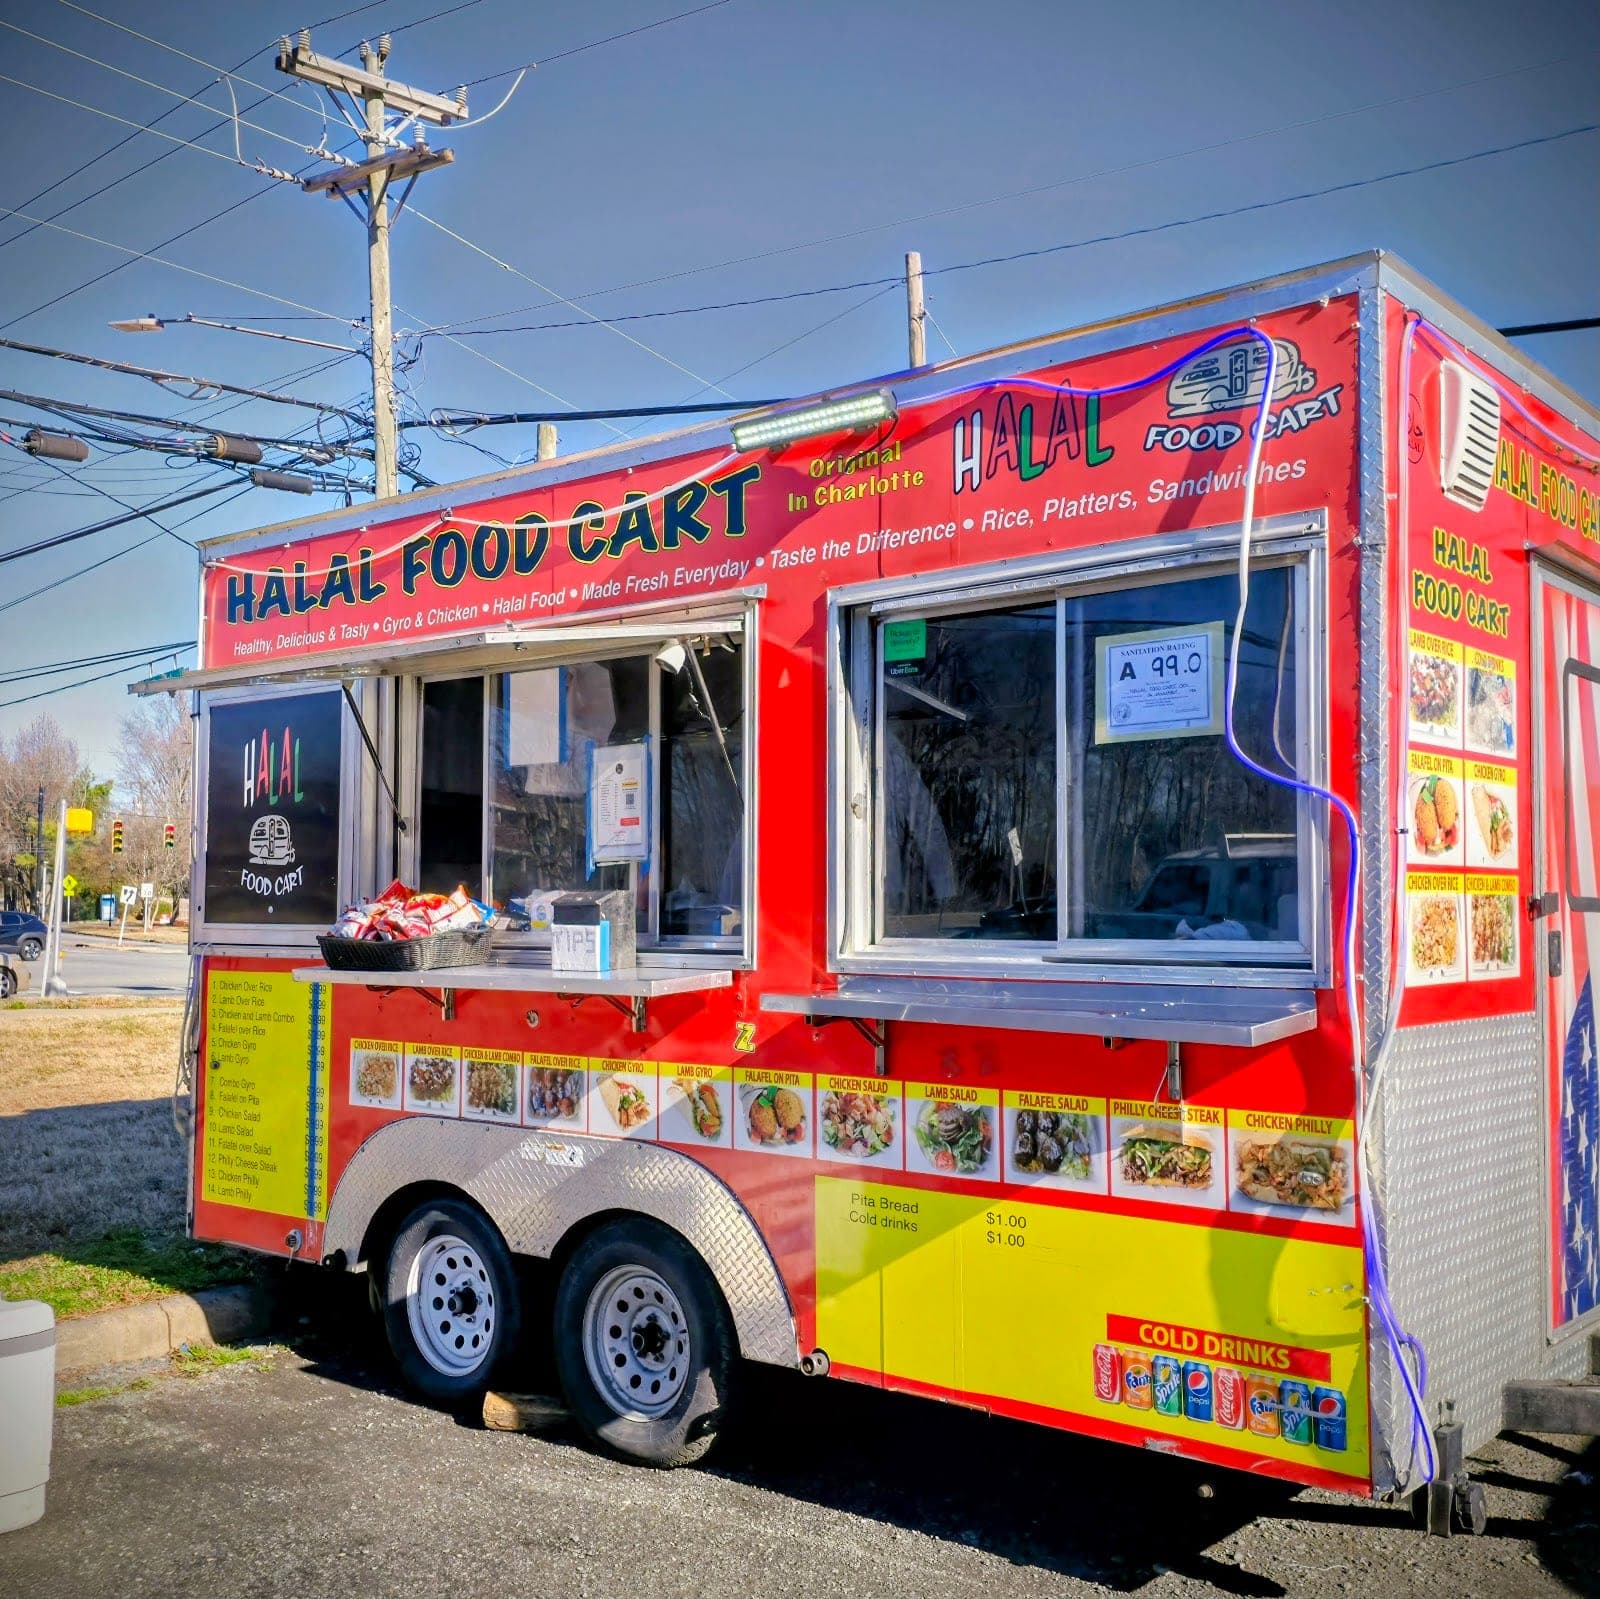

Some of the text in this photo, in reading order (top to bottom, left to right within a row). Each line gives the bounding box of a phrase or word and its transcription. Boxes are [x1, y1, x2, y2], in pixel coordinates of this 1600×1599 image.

[1144, 385, 1343, 451] FOOD CART
[954, 379, 1115, 495] HALAL
[809, 442, 902, 479] Original
[788, 468, 925, 513] In Charlotte
[1540, 463, 1578, 529] FOOD
[226, 463, 761, 625] HALAL FOOD CART
[1433, 526, 1493, 584] HALAL
[234, 638, 273, 656] Healthy,
[276, 631, 325, 650] Delicious
[328, 627, 336, 641] &
[341, 622, 369, 641] Tasty
[383, 615, 412, 634] Gyro
[415, 612, 423, 626] &
[427, 604, 478, 624] Chicken
[493, 596, 526, 615] Halal
[531, 588, 565, 608] Food
[583, 581, 620, 601] Made
[626, 572, 669, 594] Fresh
[674, 558, 749, 588] Everyday
[770, 545, 816, 570] Taste
[822, 539, 850, 559] the
[857, 521, 957, 555] Difference
[982, 506, 1033, 532] Rice,
[1044, 487, 1137, 521] Platters,
[1413, 569, 1510, 639] FOOD CART
[1121, 642, 1196, 656] SANITATION RATING
[1120, 652, 1201, 680] A 99.0
[243, 727, 304, 808] HALAL
[241, 865, 303, 896] FOOD CART
[602, 1061, 644, 1073] CHICKEN GYRO
[677, 1066, 713, 1078] LAMB GYRO
[745, 1071, 800, 1085] FALAFEL ON PITA
[830, 1078, 888, 1093] CHICKEN SALAD
[925, 1086, 977, 1101] LAMB SALAD
[1019, 1094, 1088, 1111] FALAFEL SALAD
[1113, 1101, 1147, 1117] PHILLY
[1187, 1108, 1220, 1123] STEAK
[1246, 1114, 1333, 1134] CHICKEN PHILLY
[851, 1193, 919, 1214] Pita Bread
[849, 1210, 918, 1232] Cold drinks
[986, 1212, 1027, 1229] $1.00
[986, 1231, 1025, 1247] $1.00
[1140, 1324, 1291, 1370] COLD DRINKS
